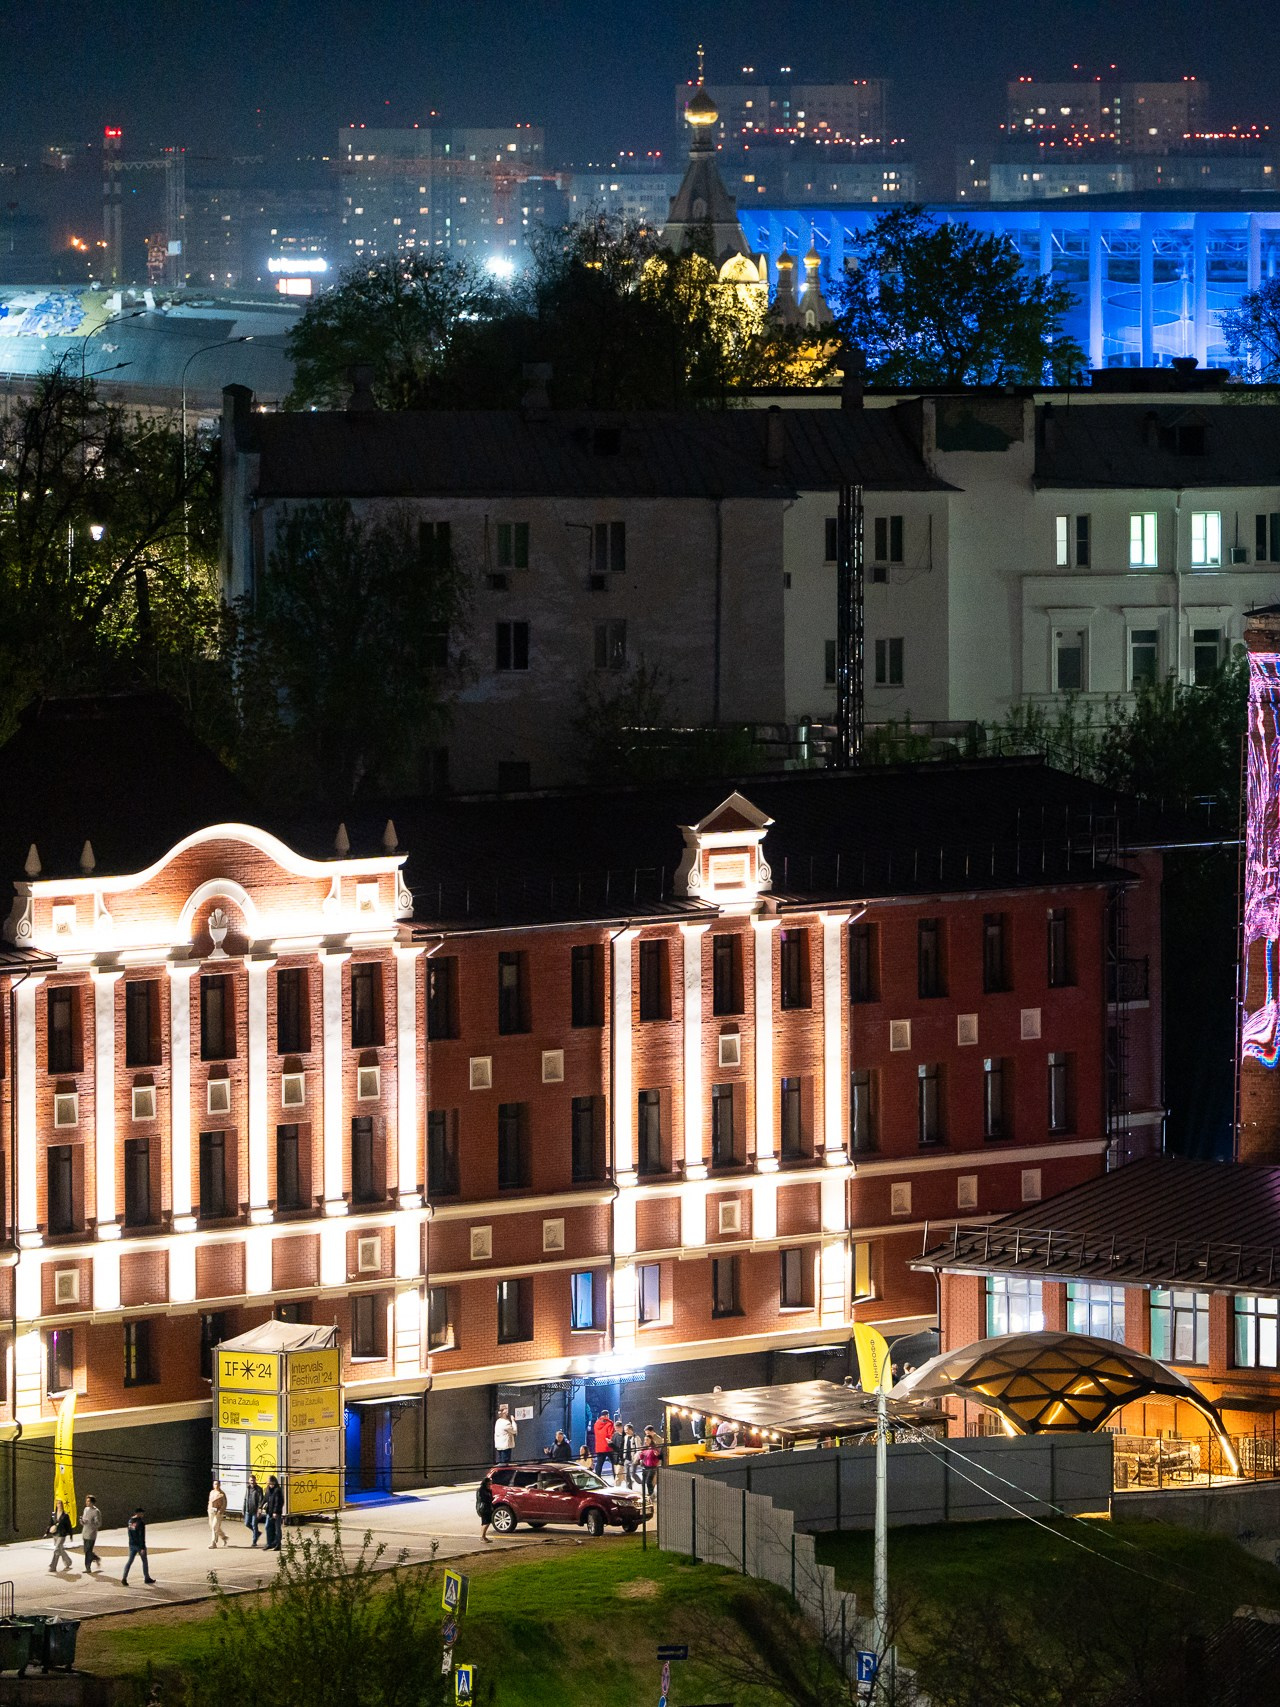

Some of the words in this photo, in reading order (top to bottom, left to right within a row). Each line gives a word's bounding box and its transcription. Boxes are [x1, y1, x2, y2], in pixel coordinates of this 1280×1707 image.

[224, 1361, 239, 1376] IF
[291, 1361, 324, 1375] Intervals
[291, 1373, 321, 1386] Festival
[222, 1411, 229, 1424] 9
[254, 1439, 268, 1453] The
[294, 1479, 318, 1495] 28.04
[862, 1655, 873, 1679] P
